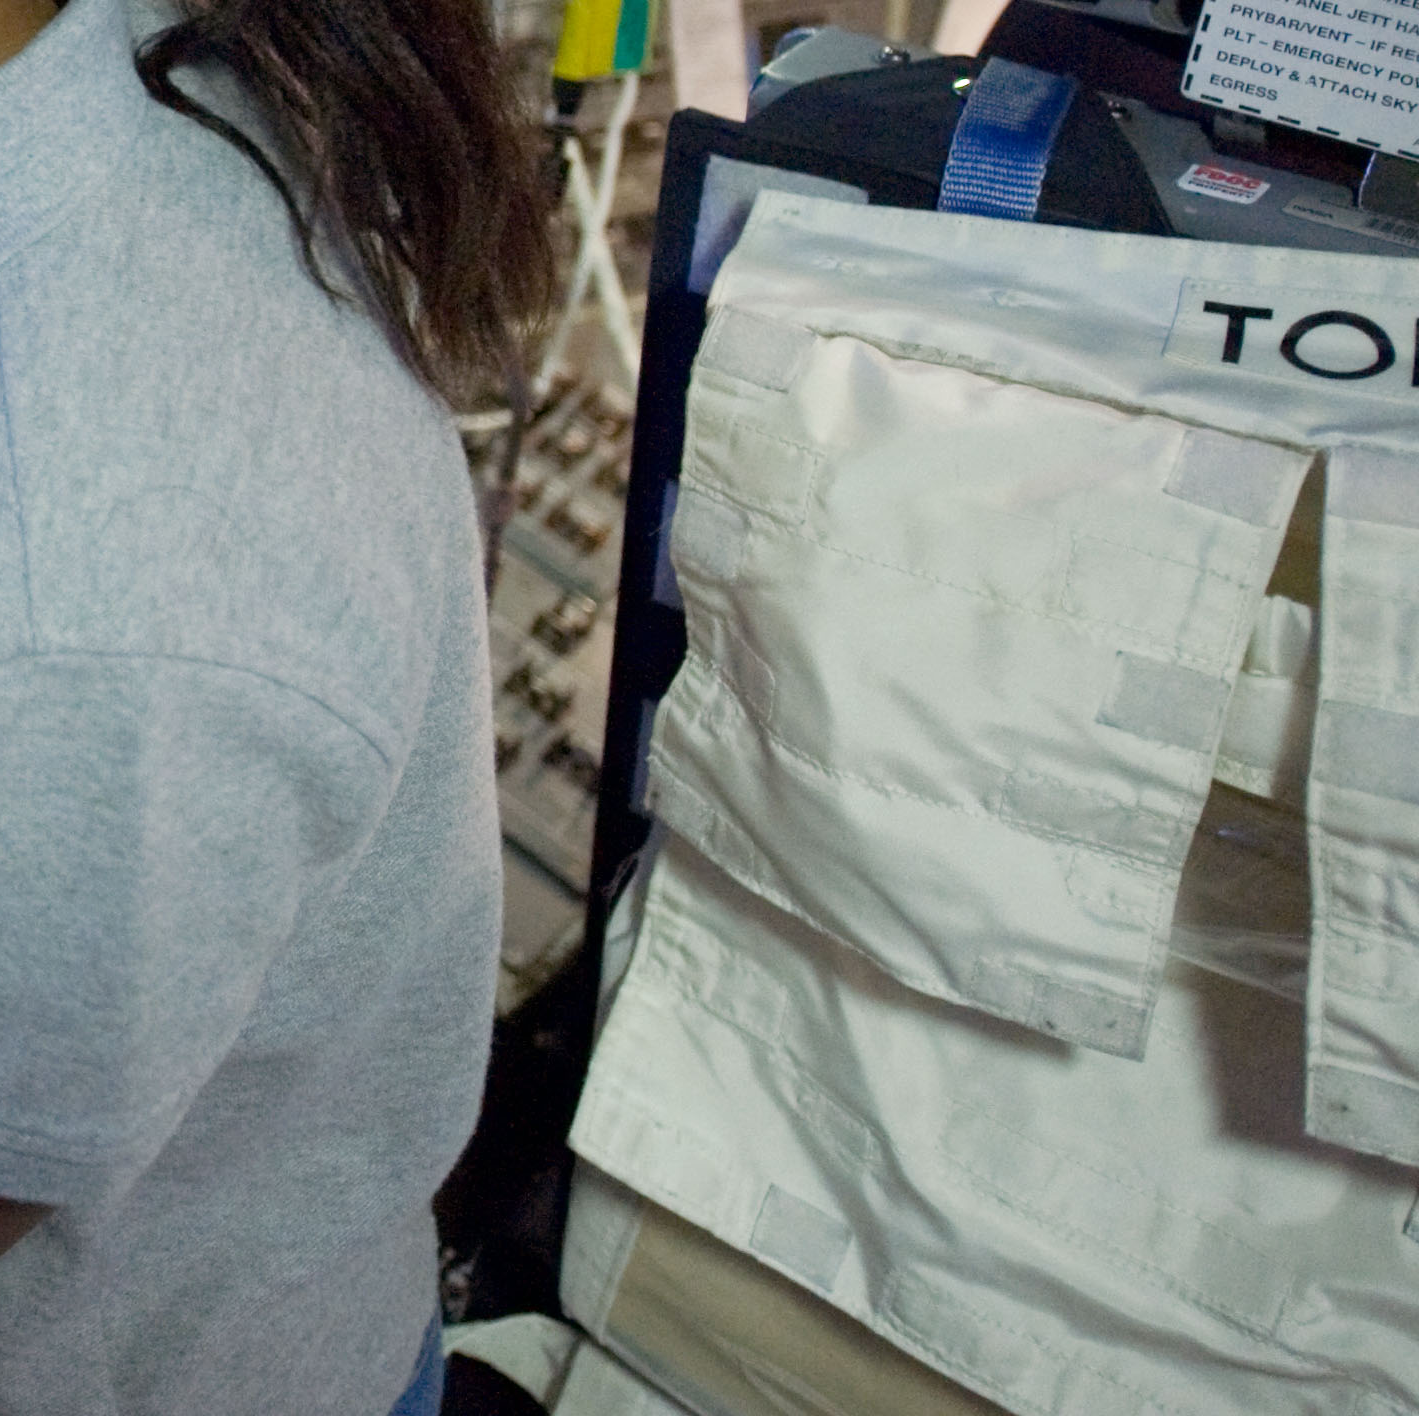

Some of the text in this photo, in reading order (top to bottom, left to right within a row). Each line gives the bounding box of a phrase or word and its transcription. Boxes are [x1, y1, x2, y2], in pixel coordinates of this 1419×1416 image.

[1230, 4, 1419, 62] PRYBAR/VENT IF RE
[1347, 9, 1392, 28] JETT
[1223, 27, 1256, 44] PLT
[1272, 38, 1384, 78] EMERGENCY
[1209, 73, 1279, 101] EGRESS
[1216, 50, 1418, 114] DEPLOY & ATTACH SKY
[1203, 300, 1419, 387] TO
